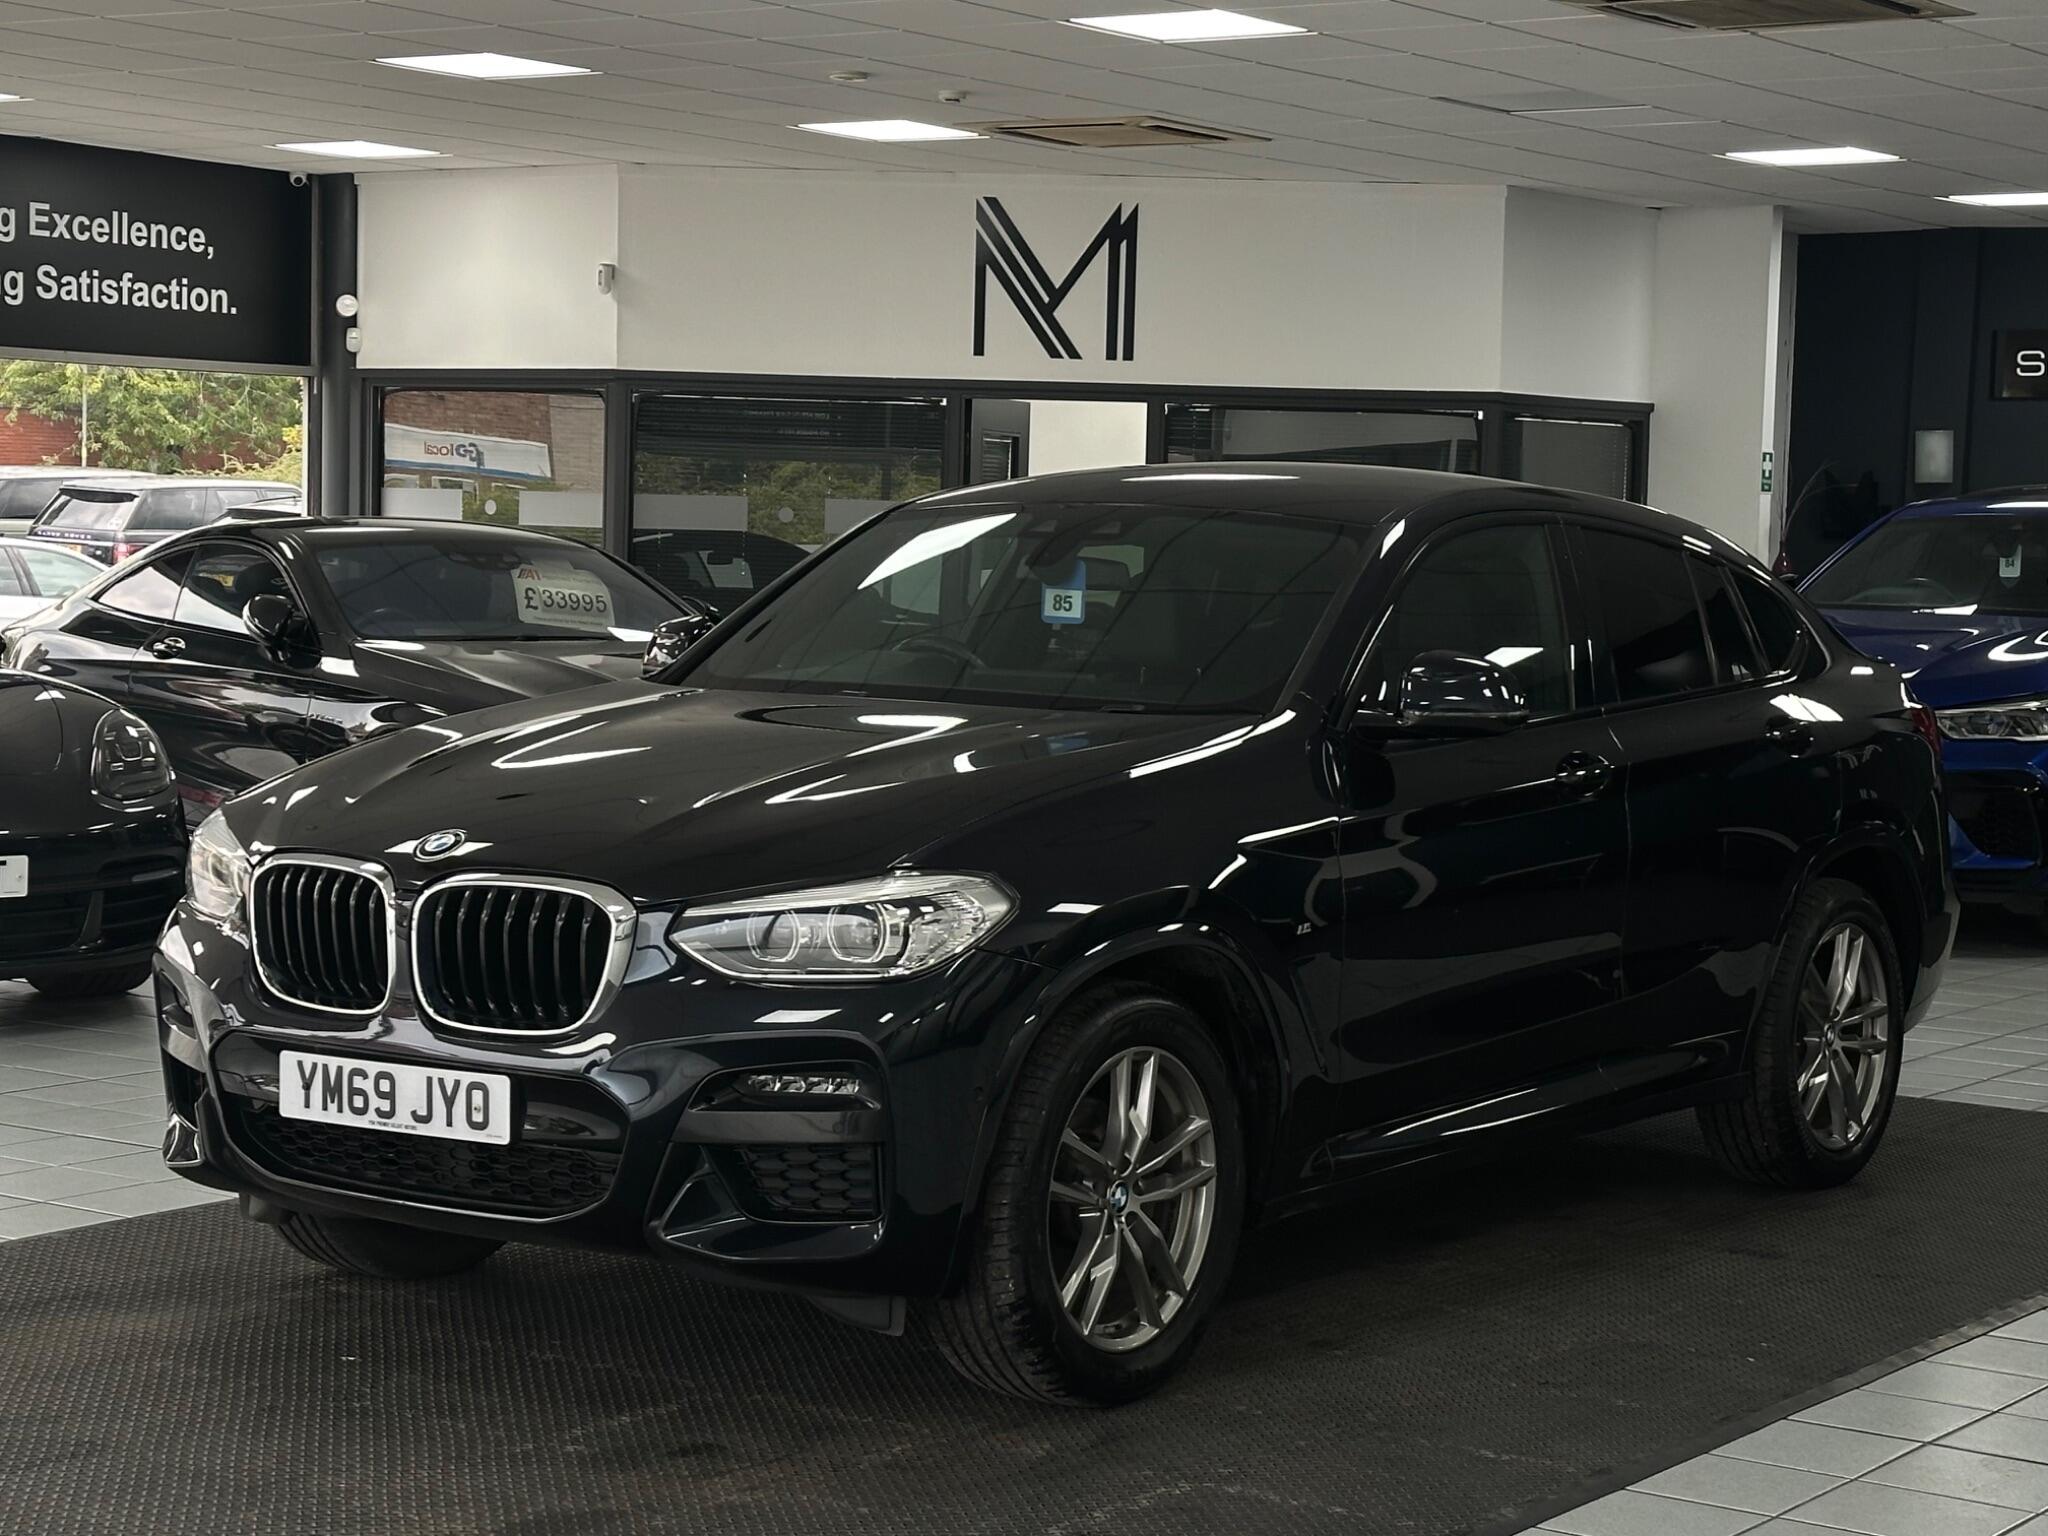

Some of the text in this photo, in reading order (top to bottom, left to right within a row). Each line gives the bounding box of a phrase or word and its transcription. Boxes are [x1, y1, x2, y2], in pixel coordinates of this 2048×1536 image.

[29, 201, 214, 260] Excellence,
[0, 264, 238, 315] g Satisfaction.
[2016, 350, 2045, 377] S
[1052, 594, 1073, 612] 85
[296, 1059, 490, 1131] YM69 JYO
